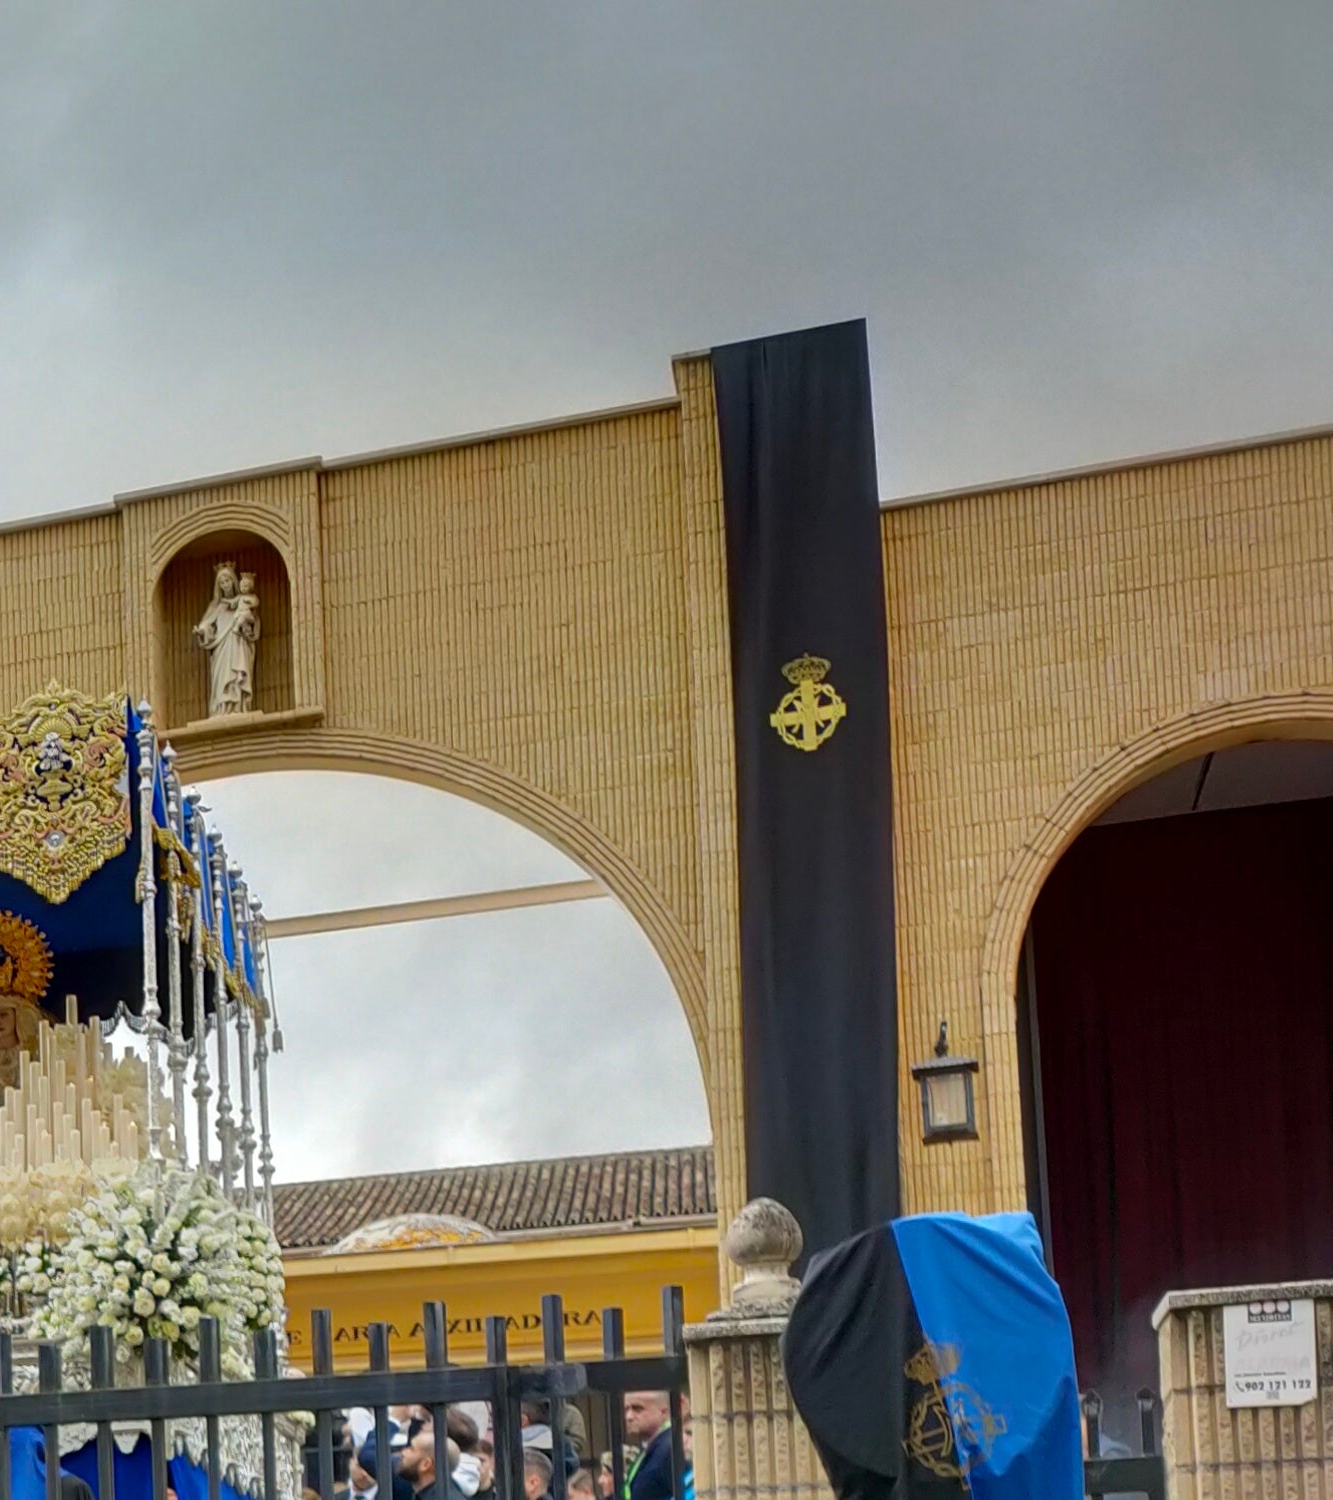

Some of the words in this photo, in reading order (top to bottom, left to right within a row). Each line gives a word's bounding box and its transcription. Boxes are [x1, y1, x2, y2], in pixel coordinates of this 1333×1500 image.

[1244, 1380, 1265, 1392] 902
[1269, 1380, 1287, 1391] 121
[1292, 1378, 1312, 1390] 122
